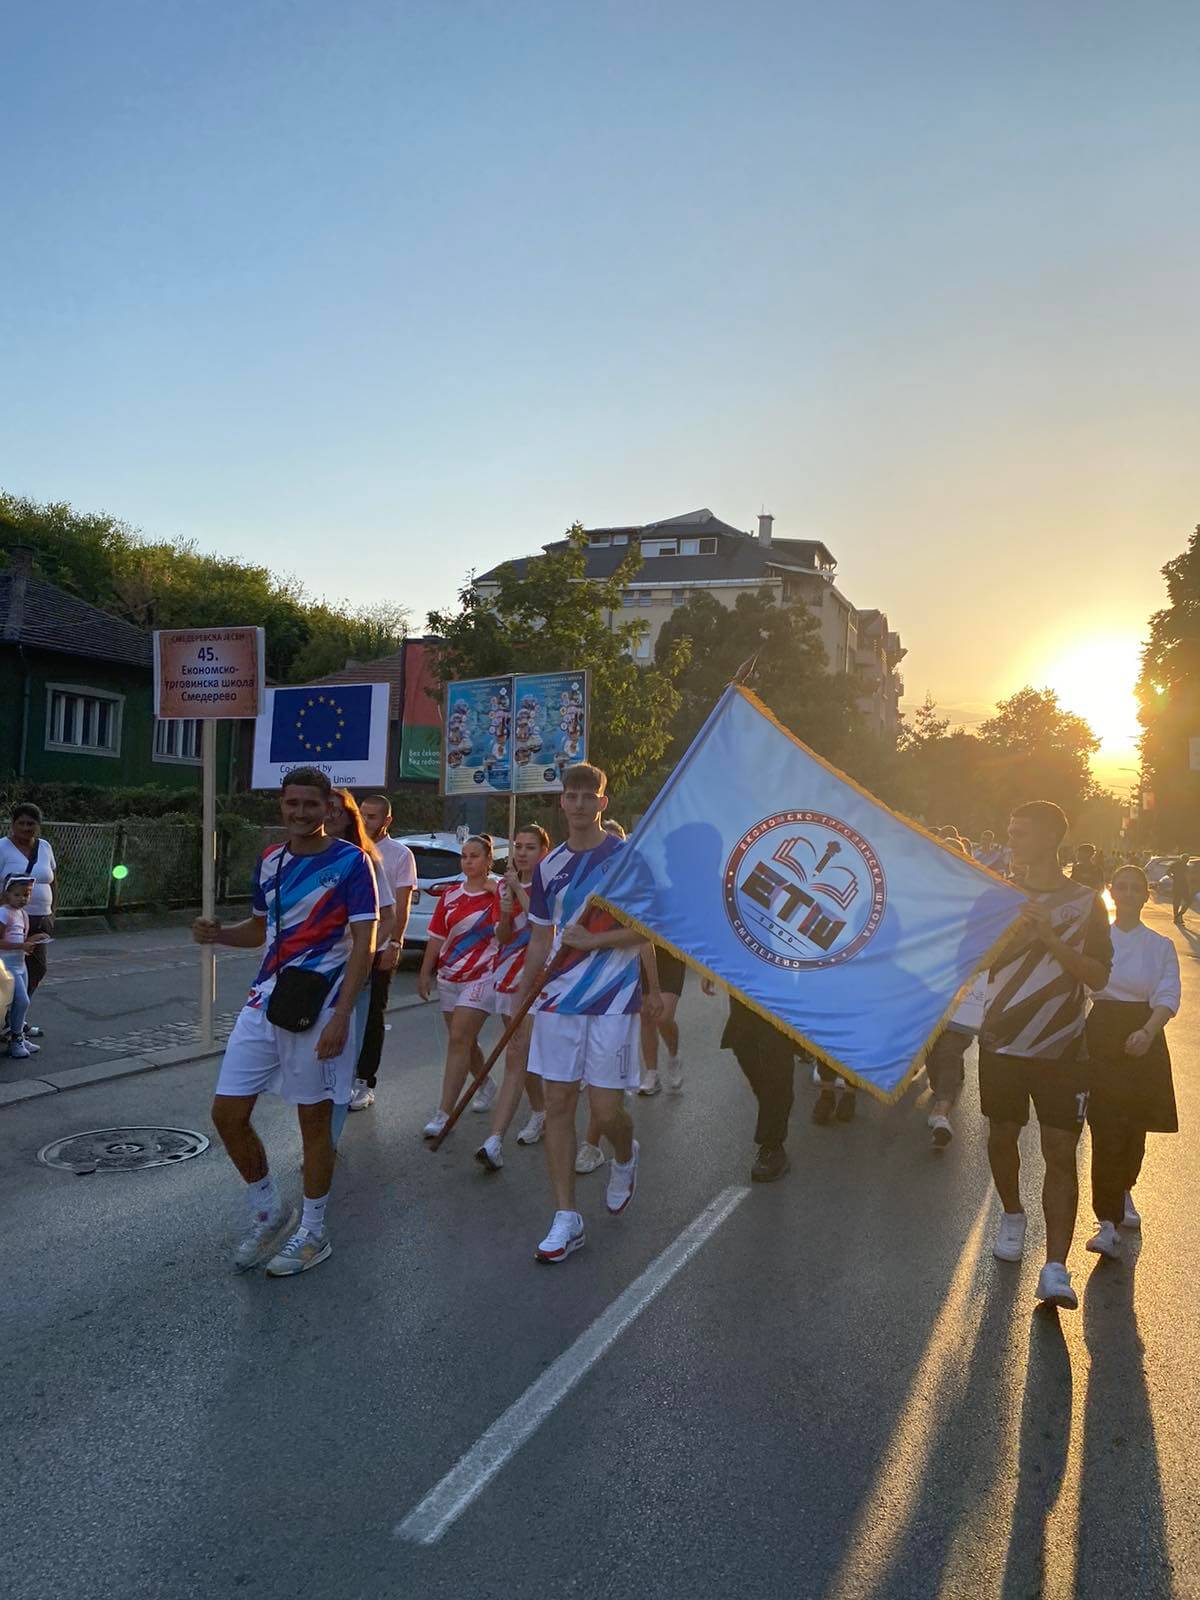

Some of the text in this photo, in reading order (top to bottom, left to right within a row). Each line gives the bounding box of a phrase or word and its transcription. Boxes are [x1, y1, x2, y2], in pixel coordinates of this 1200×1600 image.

[197, 646, 219, 661] 45.
[181, 665, 239, 675] Економско-
[165, 678, 255, 691] трговинска школа
[181, 691, 237, 703] Смедерево
[322, 763, 332, 774] by
[333, 775, 356, 784] Union
[733, 919, 800, 968] СМЕДЕРЕВО
